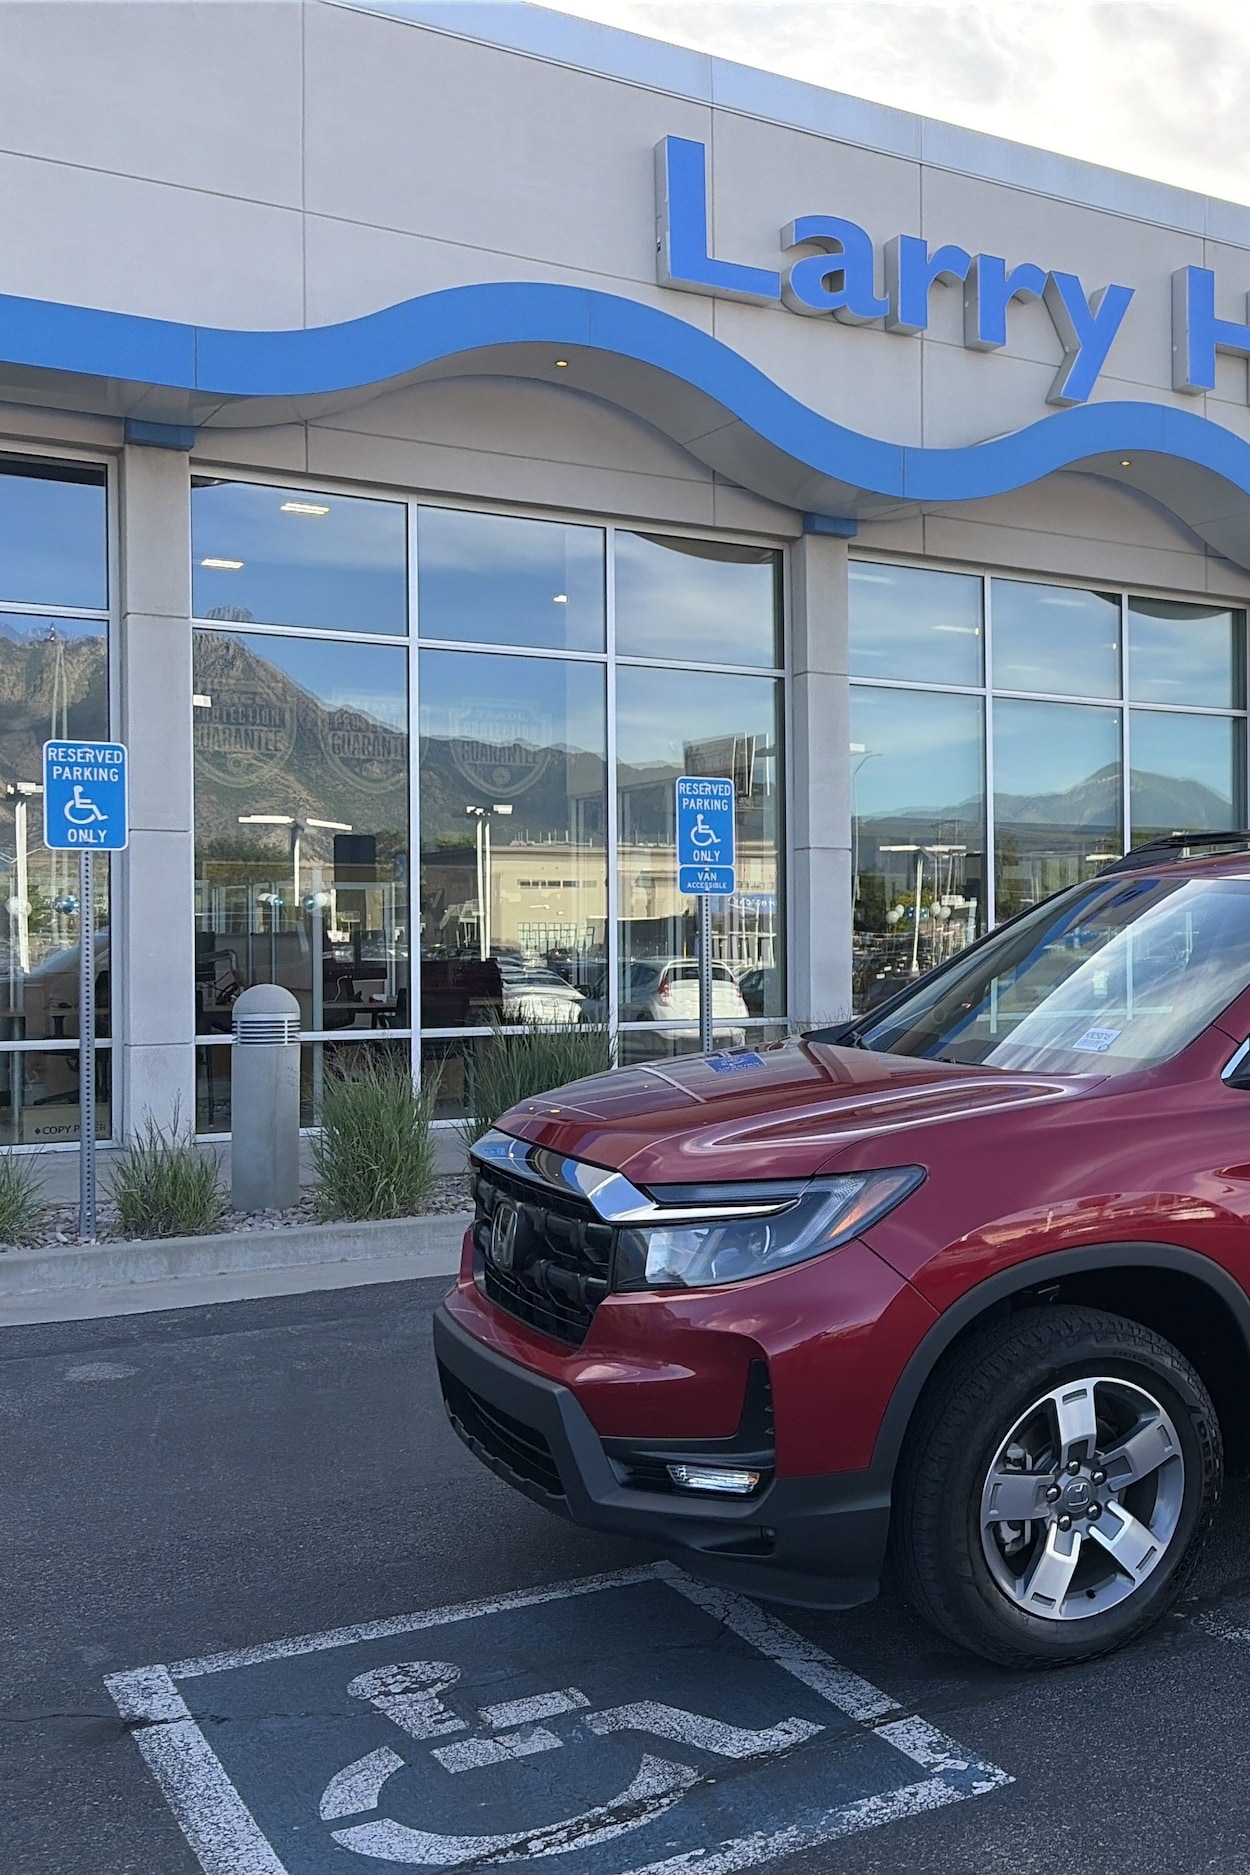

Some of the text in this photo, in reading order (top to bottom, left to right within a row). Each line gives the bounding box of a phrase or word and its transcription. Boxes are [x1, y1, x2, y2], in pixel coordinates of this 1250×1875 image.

[660, 135, 1135, 405] Larry
[48, 748, 123, 764] RESERVED
[53, 766, 119, 782] PARKING
[680, 783, 731, 796] RESERVED
[682, 798, 729, 811] PARKING
[67, 829, 108, 843] ONLY
[693, 850, 720, 862] ONLY
[697, 872, 717, 881] VAN
[42, 1122, 106, 1135] COPY PER
